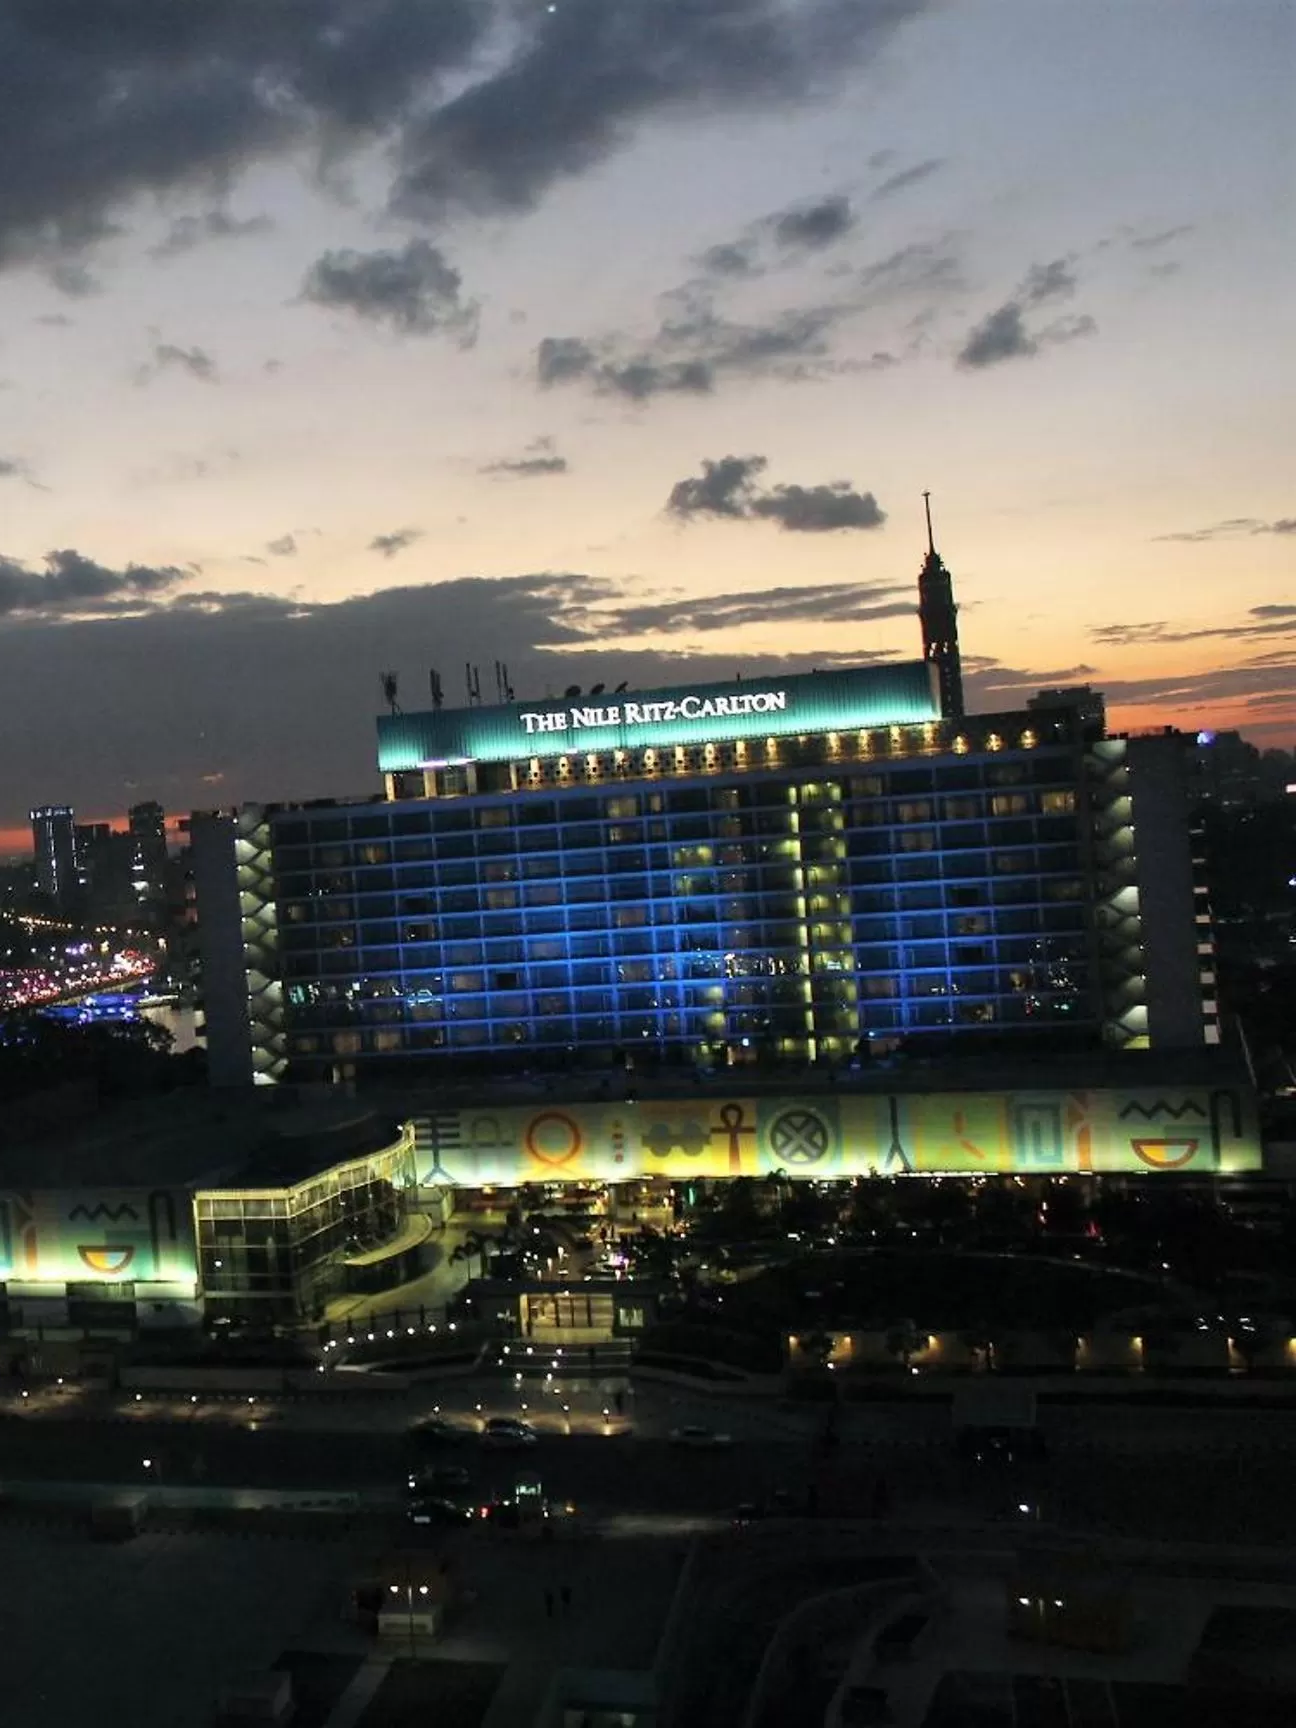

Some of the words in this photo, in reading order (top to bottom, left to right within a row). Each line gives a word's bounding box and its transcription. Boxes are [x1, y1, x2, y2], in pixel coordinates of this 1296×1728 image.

[520, 712, 567, 734] THE
[570, 706, 622, 729] NILE
[623, 691, 787, 725] RITZ-CARLTON
